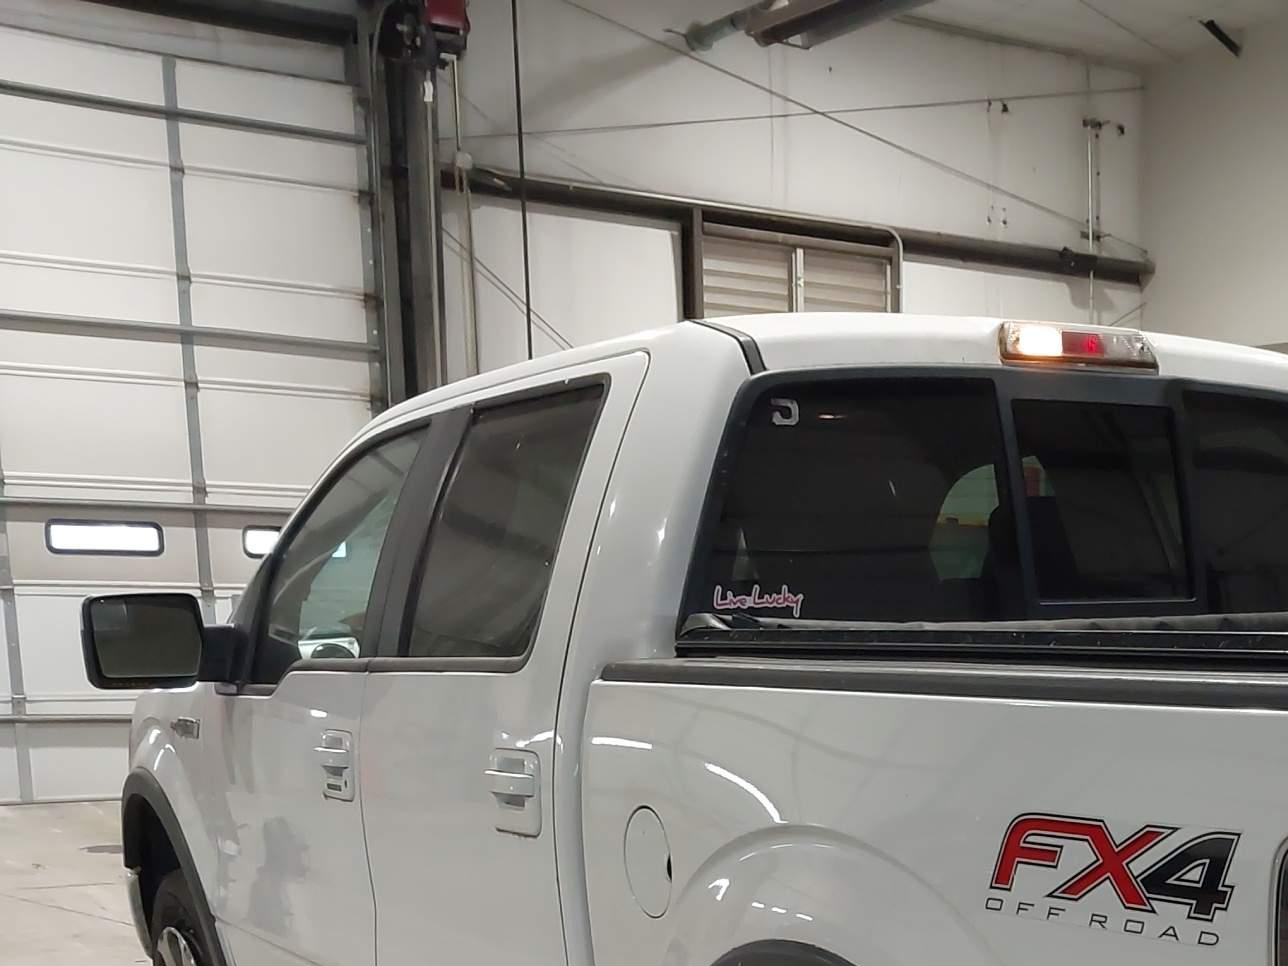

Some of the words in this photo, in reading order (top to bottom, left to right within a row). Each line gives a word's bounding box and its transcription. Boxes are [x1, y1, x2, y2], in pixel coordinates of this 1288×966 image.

[713, 585, 749, 609] Live
[751, 584, 804, 618] Lucky
[989, 812, 1242, 922] FX4
[985, 897, 1066, 921] OFF
[1088, 913, 1220, 946] ROAD
